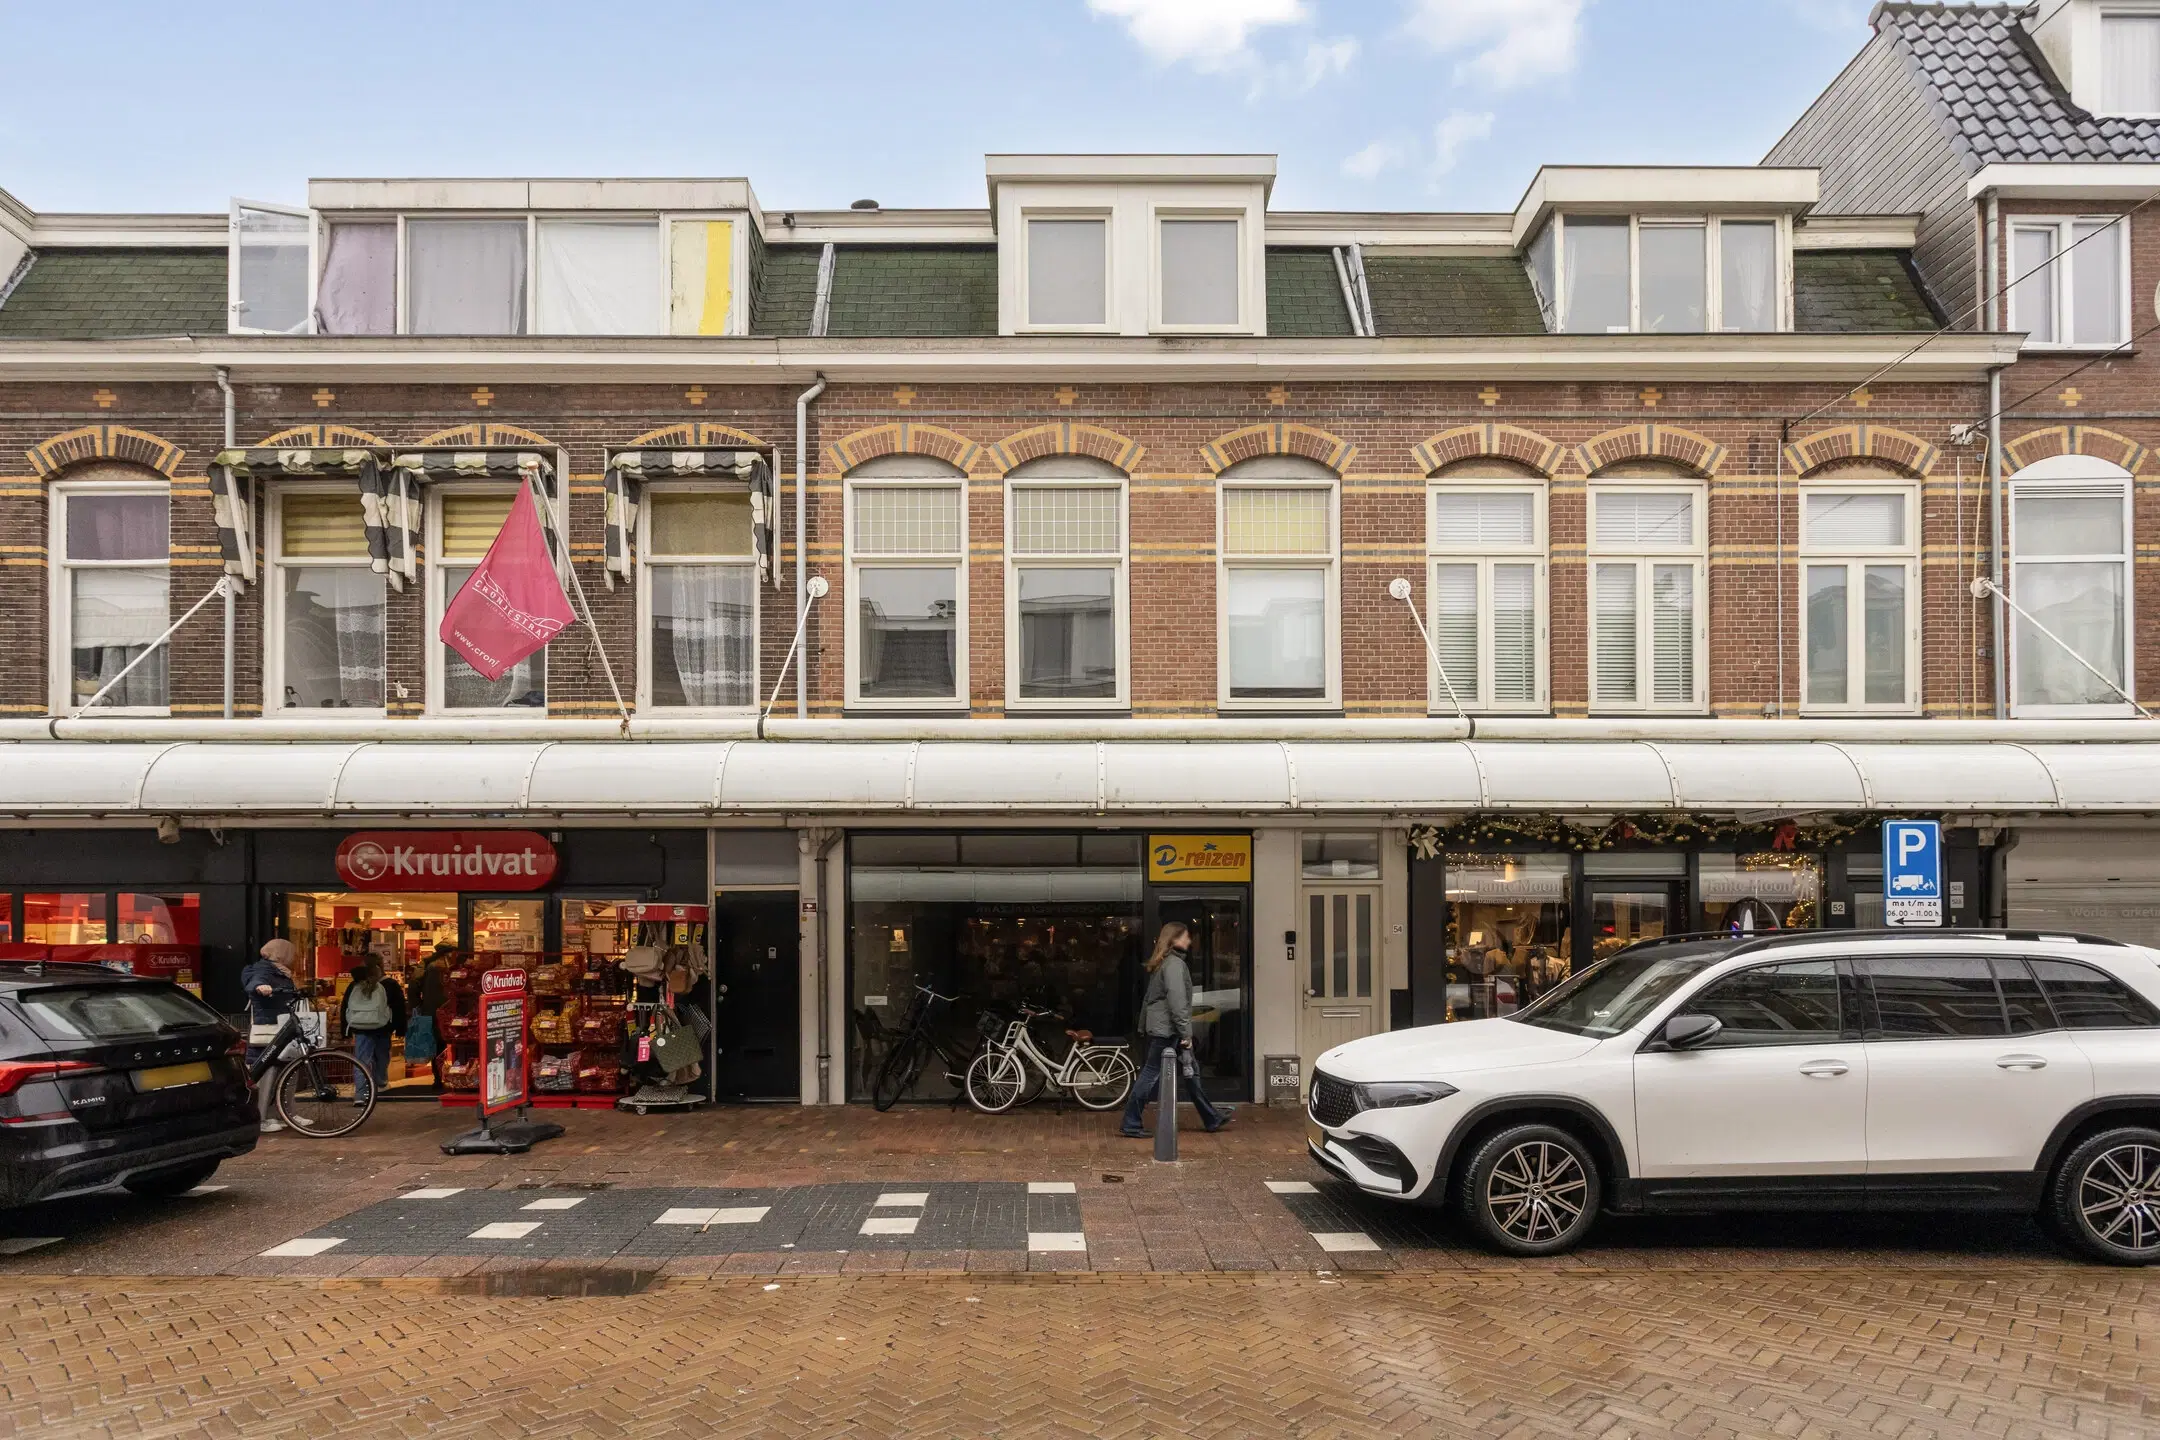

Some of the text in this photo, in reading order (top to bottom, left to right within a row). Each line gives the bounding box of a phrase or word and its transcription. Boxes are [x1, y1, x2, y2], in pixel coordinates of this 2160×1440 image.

[1899, 828, 1927, 866] P
[393, 844, 538, 876] Kruidvat
[1154, 844, 1247, 867] D-reizen
[1520, 879, 1561, 893] Moon
[1832, 904, 1844, 912] 52
[1908, 899, 1925, 907] t/m
[493, 973, 524, 988] Kruidvat
[71, 1096, 106, 1106] KAMIQ
